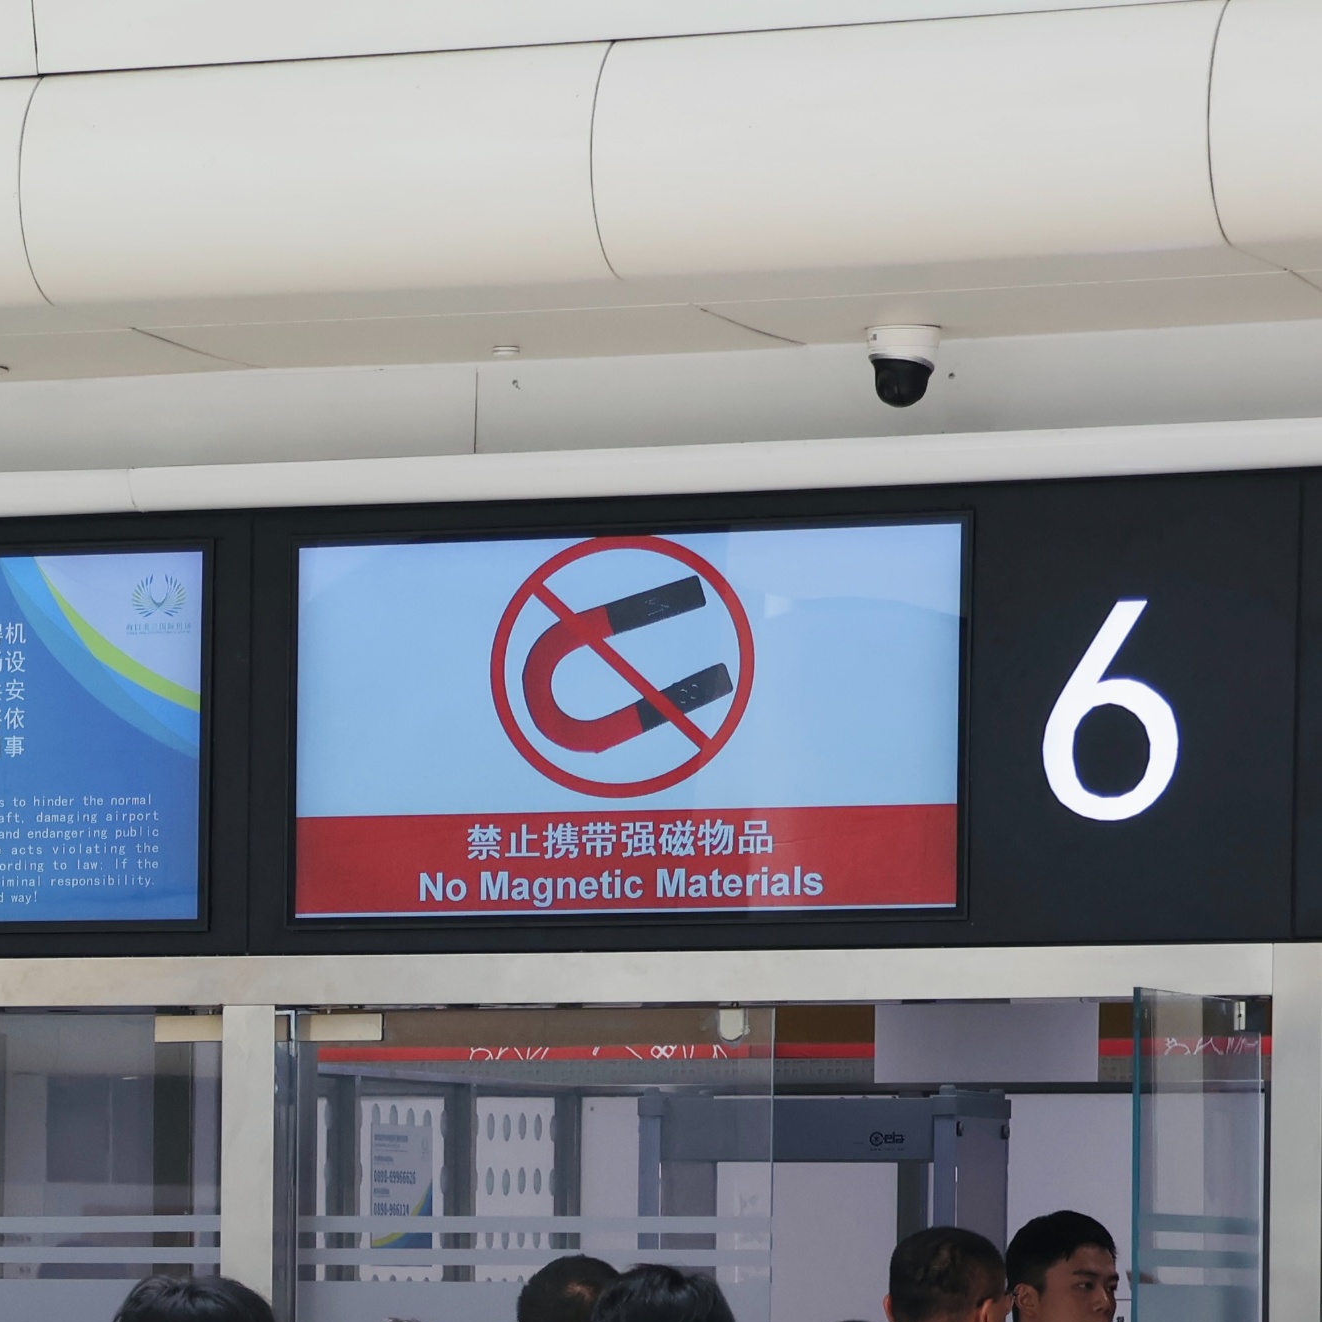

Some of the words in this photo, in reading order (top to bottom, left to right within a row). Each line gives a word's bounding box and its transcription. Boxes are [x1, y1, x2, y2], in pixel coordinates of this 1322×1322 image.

[1043, 600, 1179, 821] 6
[12, 796, 27, 808] to
[32, 794, 75, 807] hinder
[82, 794, 105, 807] the
[109, 793, 152, 806] normal
[35, 810, 99, 825] damaging
[105, 809, 160, 824] airport
[26, 826, 109, 842] endangering
[114, 825, 160, 840] public
[466, 819, 776, 861] 禁止携带强磁物品
[10, 844, 44, 856] acts
[51, 842, 127, 857] violating
[135, 841, 160, 854] the
[51, 859, 68, 871] to
[114, 857, 129, 870] If
[136, 857, 160, 870] the
[419, 872, 468, 902] No
[479, 870, 644, 908] Magnetic
[656, 865, 825, 898] Materials
